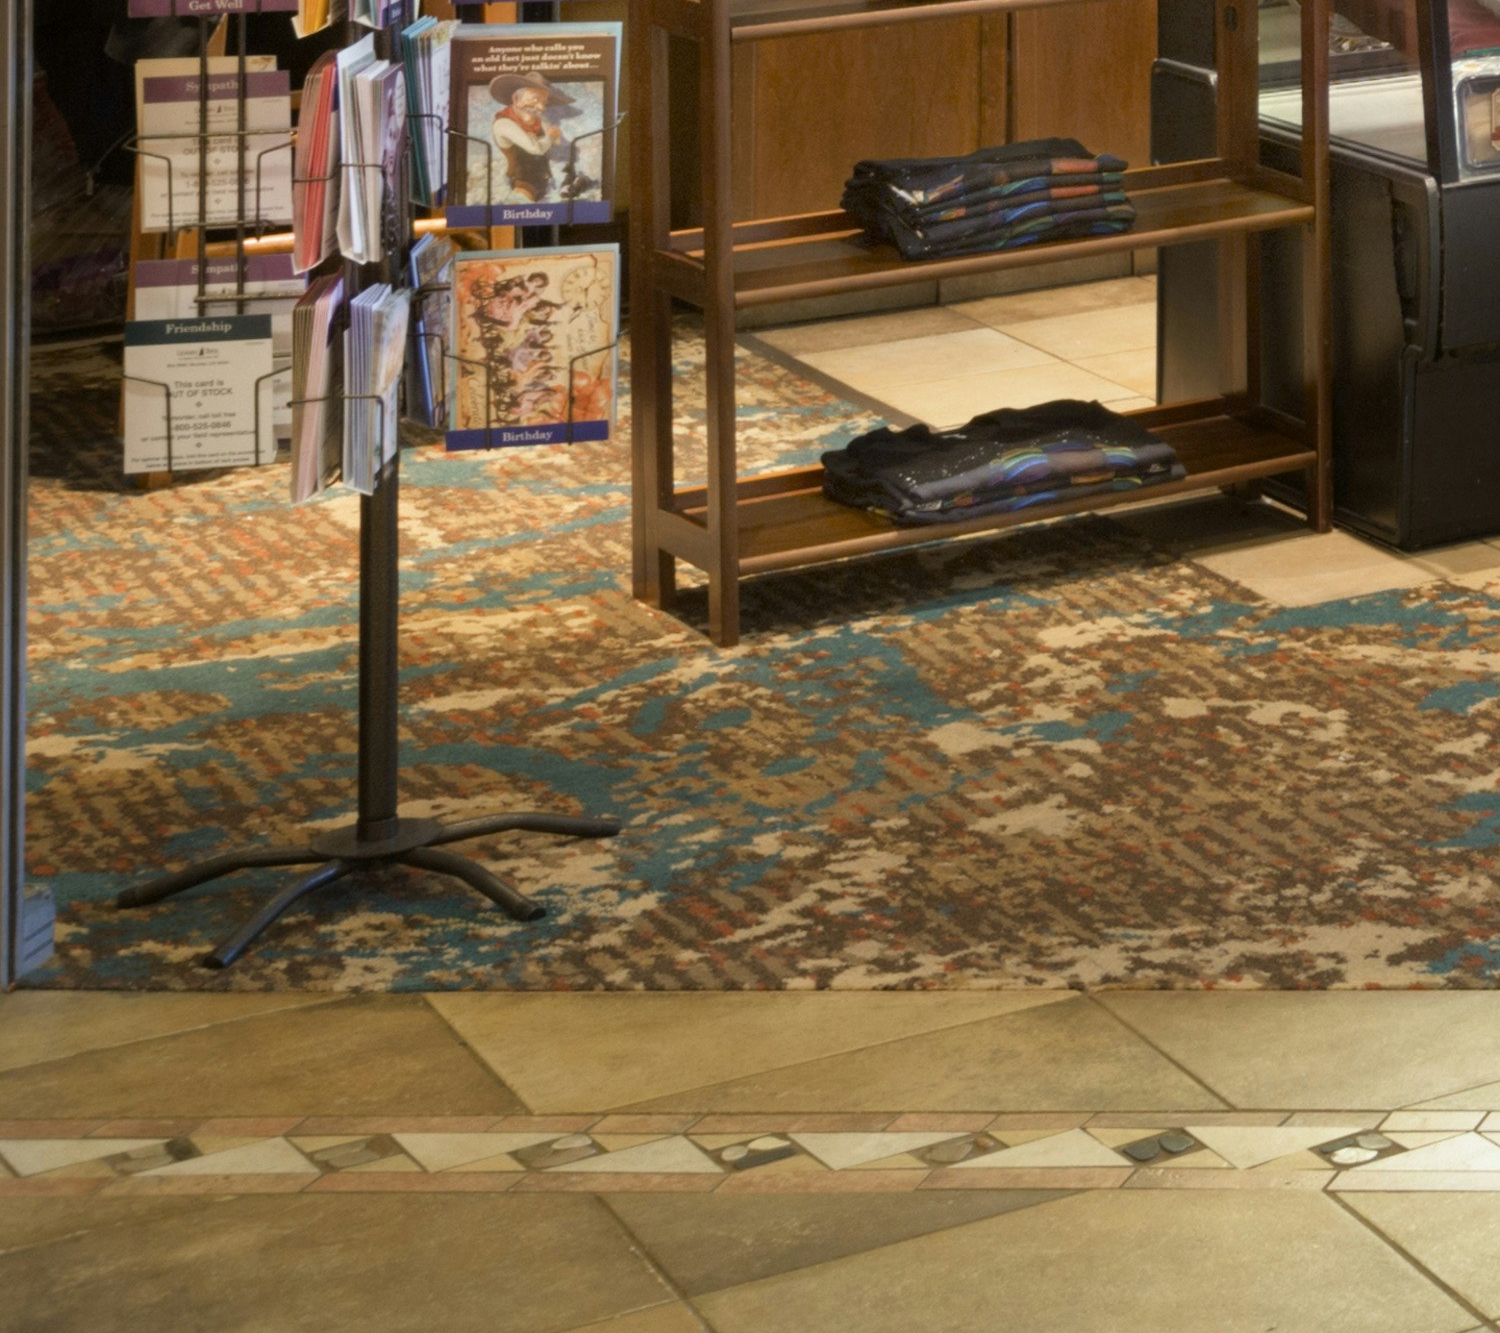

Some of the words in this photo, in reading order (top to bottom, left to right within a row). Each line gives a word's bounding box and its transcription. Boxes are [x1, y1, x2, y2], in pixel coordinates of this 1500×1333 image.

[189, 0, 213, 12] Get
[503, 209, 554, 221] Birthday
[165, 321, 233, 335] Friendship
[502, 430, 554, 443] Birthday
